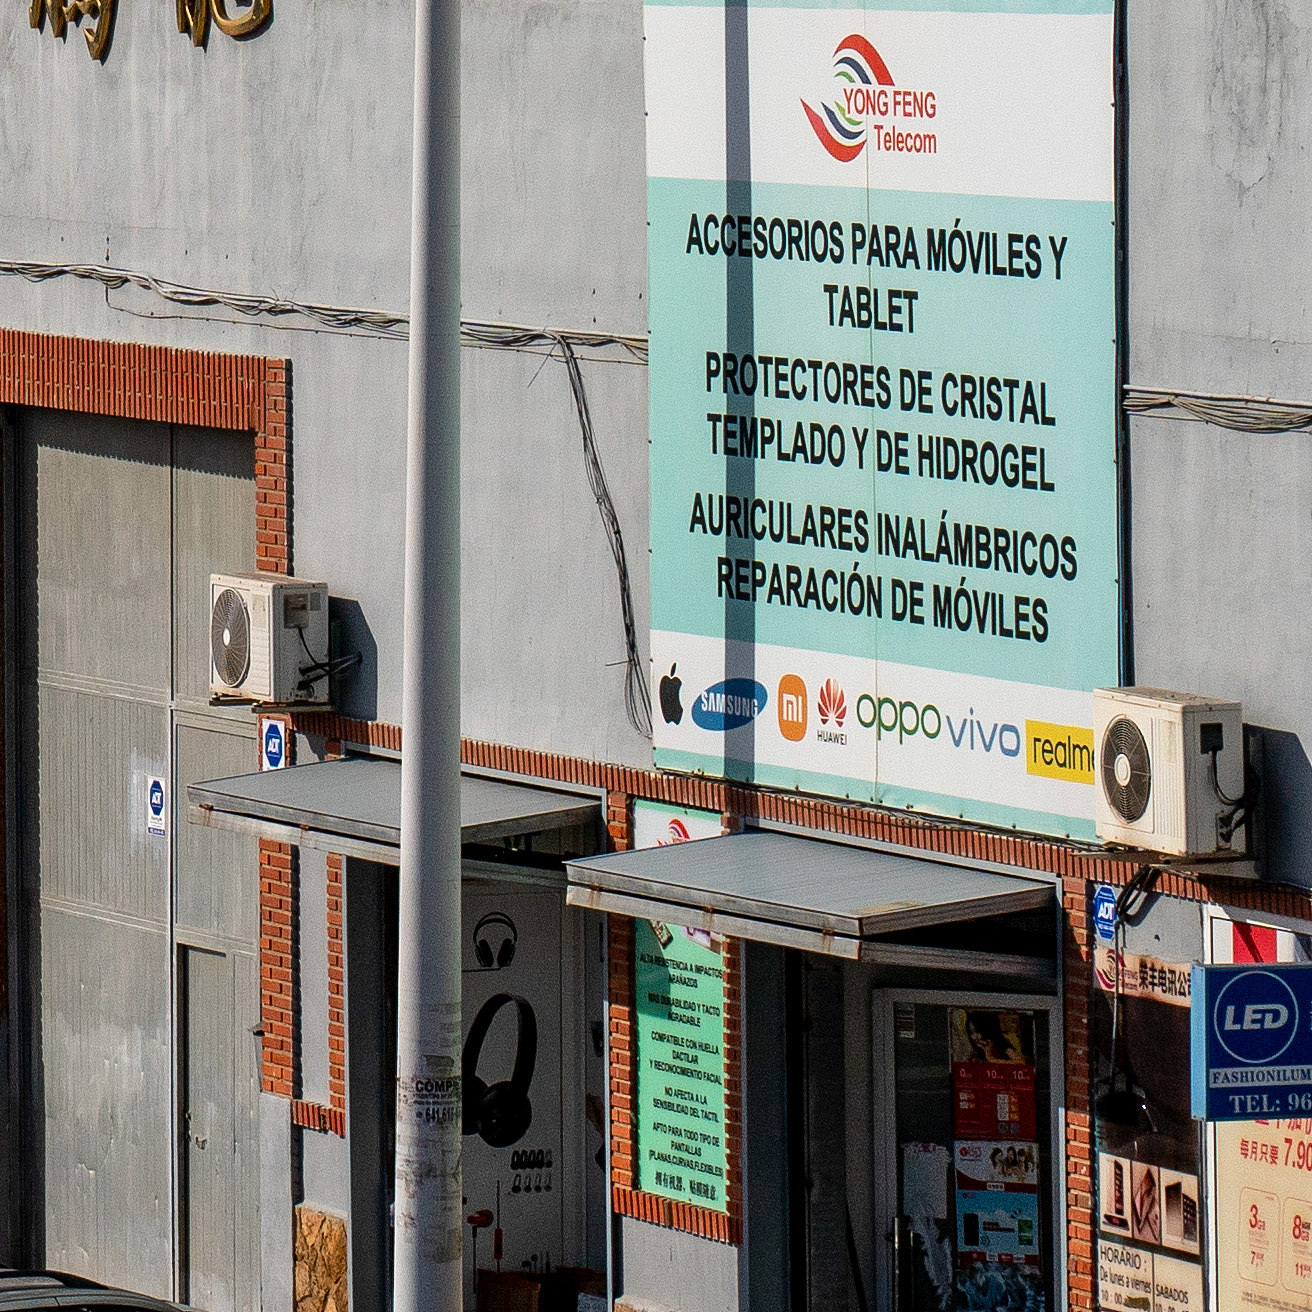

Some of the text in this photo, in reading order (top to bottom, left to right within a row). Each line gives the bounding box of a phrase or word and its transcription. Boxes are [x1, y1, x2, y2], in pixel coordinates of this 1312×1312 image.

[843, 88, 936, 119] YONG FENG
[874, 124, 937, 154] Telecom
[686, 213, 1068, 280] ACCESORIOS PARA MÓVILES Y
[824, 283, 918, 333] TABLET
[706, 351, 1056, 426] PROTECTORES DE CRISTAL
[707, 413, 1055, 492] TEMPLADO Y DE HIDROGEL
[689, 492, 1077, 581] AURICULARES INALÁMBRICOS
[718, 556, 1049, 643] REPARACIÓN DE MÓVILES
[700, 690, 760, 719] SAMSUNG
[816, 731, 848, 746] HUAWEI
[856, 693, 941, 745] oppo
[946, 707, 1021, 758] vivo
[1097, 901, 1115, 920] ADT
[1224, 1003, 1289, 1031] LED
